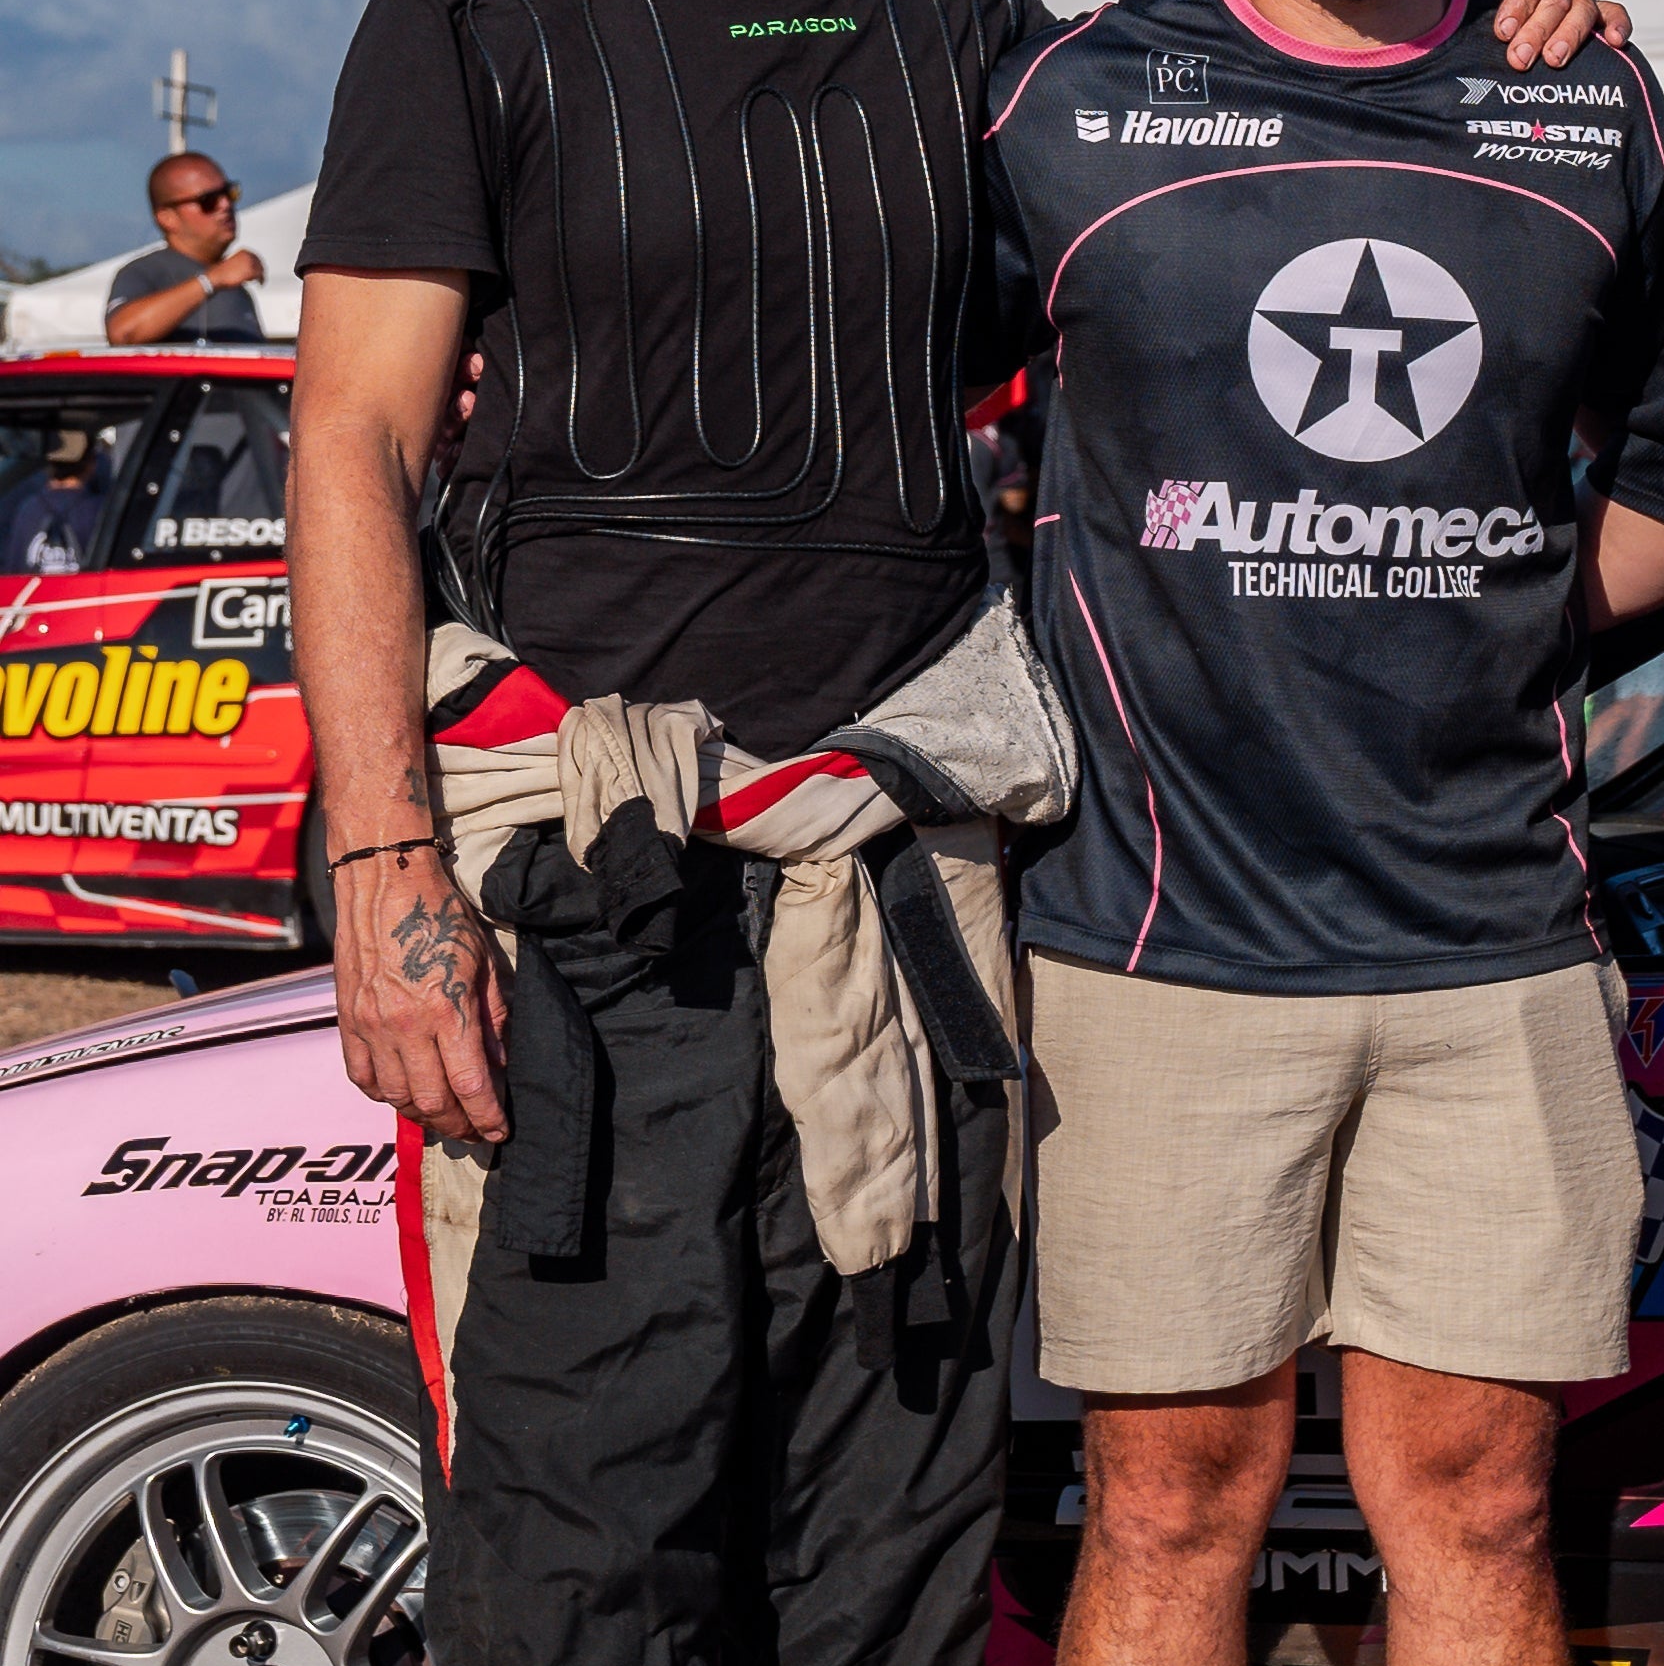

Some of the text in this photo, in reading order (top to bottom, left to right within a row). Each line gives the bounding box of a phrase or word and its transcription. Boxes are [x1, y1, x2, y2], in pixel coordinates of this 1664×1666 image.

[729, 17, 857, 39] PARAGON
[1496, 83, 1626, 108] YOKOHAMA
[1120, 110, 1284, 148] Havoline
[1544, 124, 1623, 149] STAR
[1473, 142, 1613, 170] MOTORING
[1177, 480, 1545, 559] Automeca
[1228, 560, 1484, 599] TECHNICAL COLLEGE
[0, 644, 250, 738] voline
[0, 801, 240, 846] MULTIVENTAS
[255, 1188, 312, 1207] TOA
[266, 1207, 382, 1225] BY: RL TOOLS, LLC
